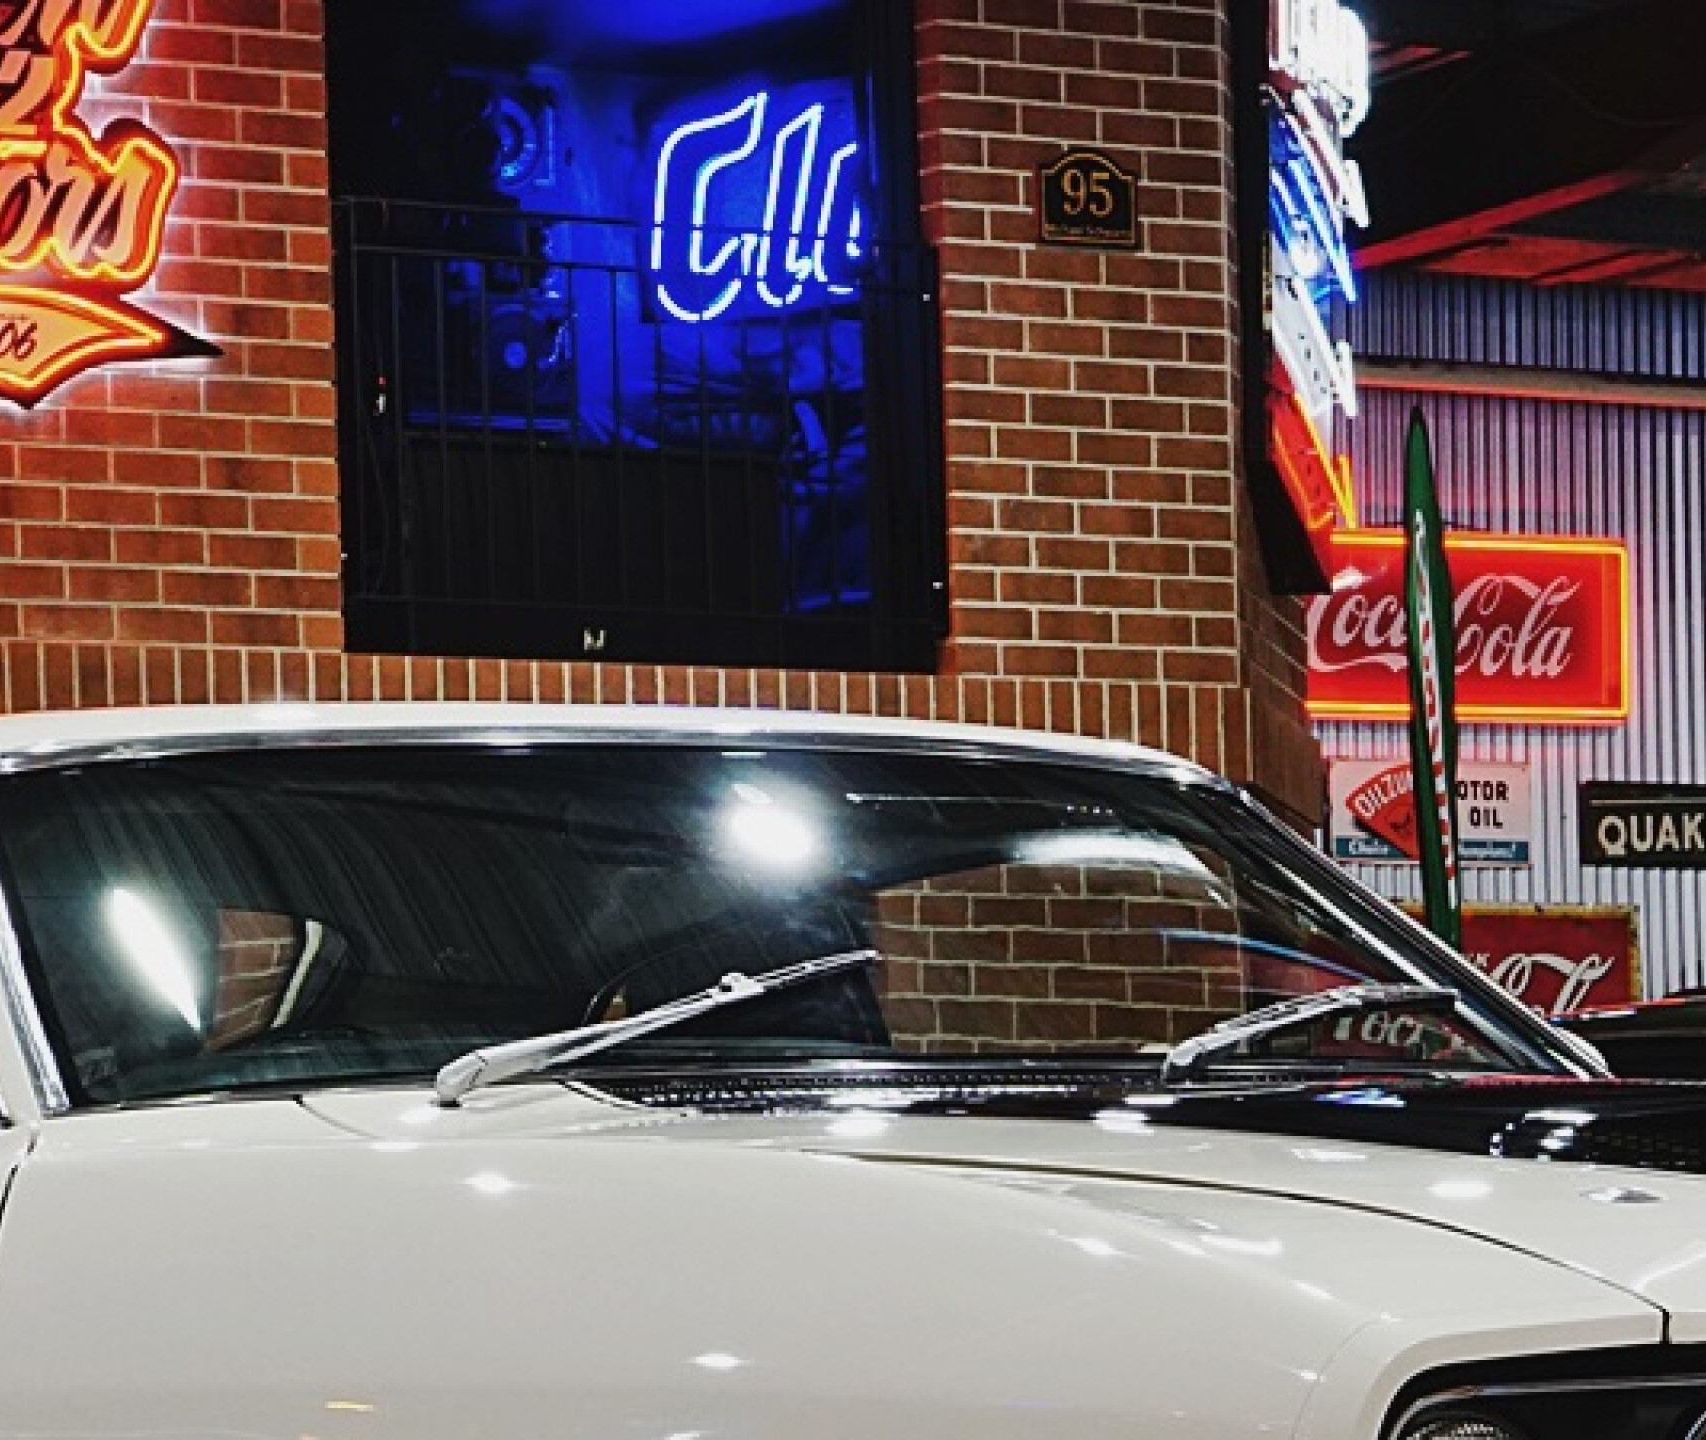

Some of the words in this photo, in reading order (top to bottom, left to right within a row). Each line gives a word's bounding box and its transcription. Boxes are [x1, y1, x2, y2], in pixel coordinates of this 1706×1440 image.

[1061, 168, 1114, 218] 95
[1456, 780, 1510, 801] OTOR
[1469, 806, 1504, 830] OIL
